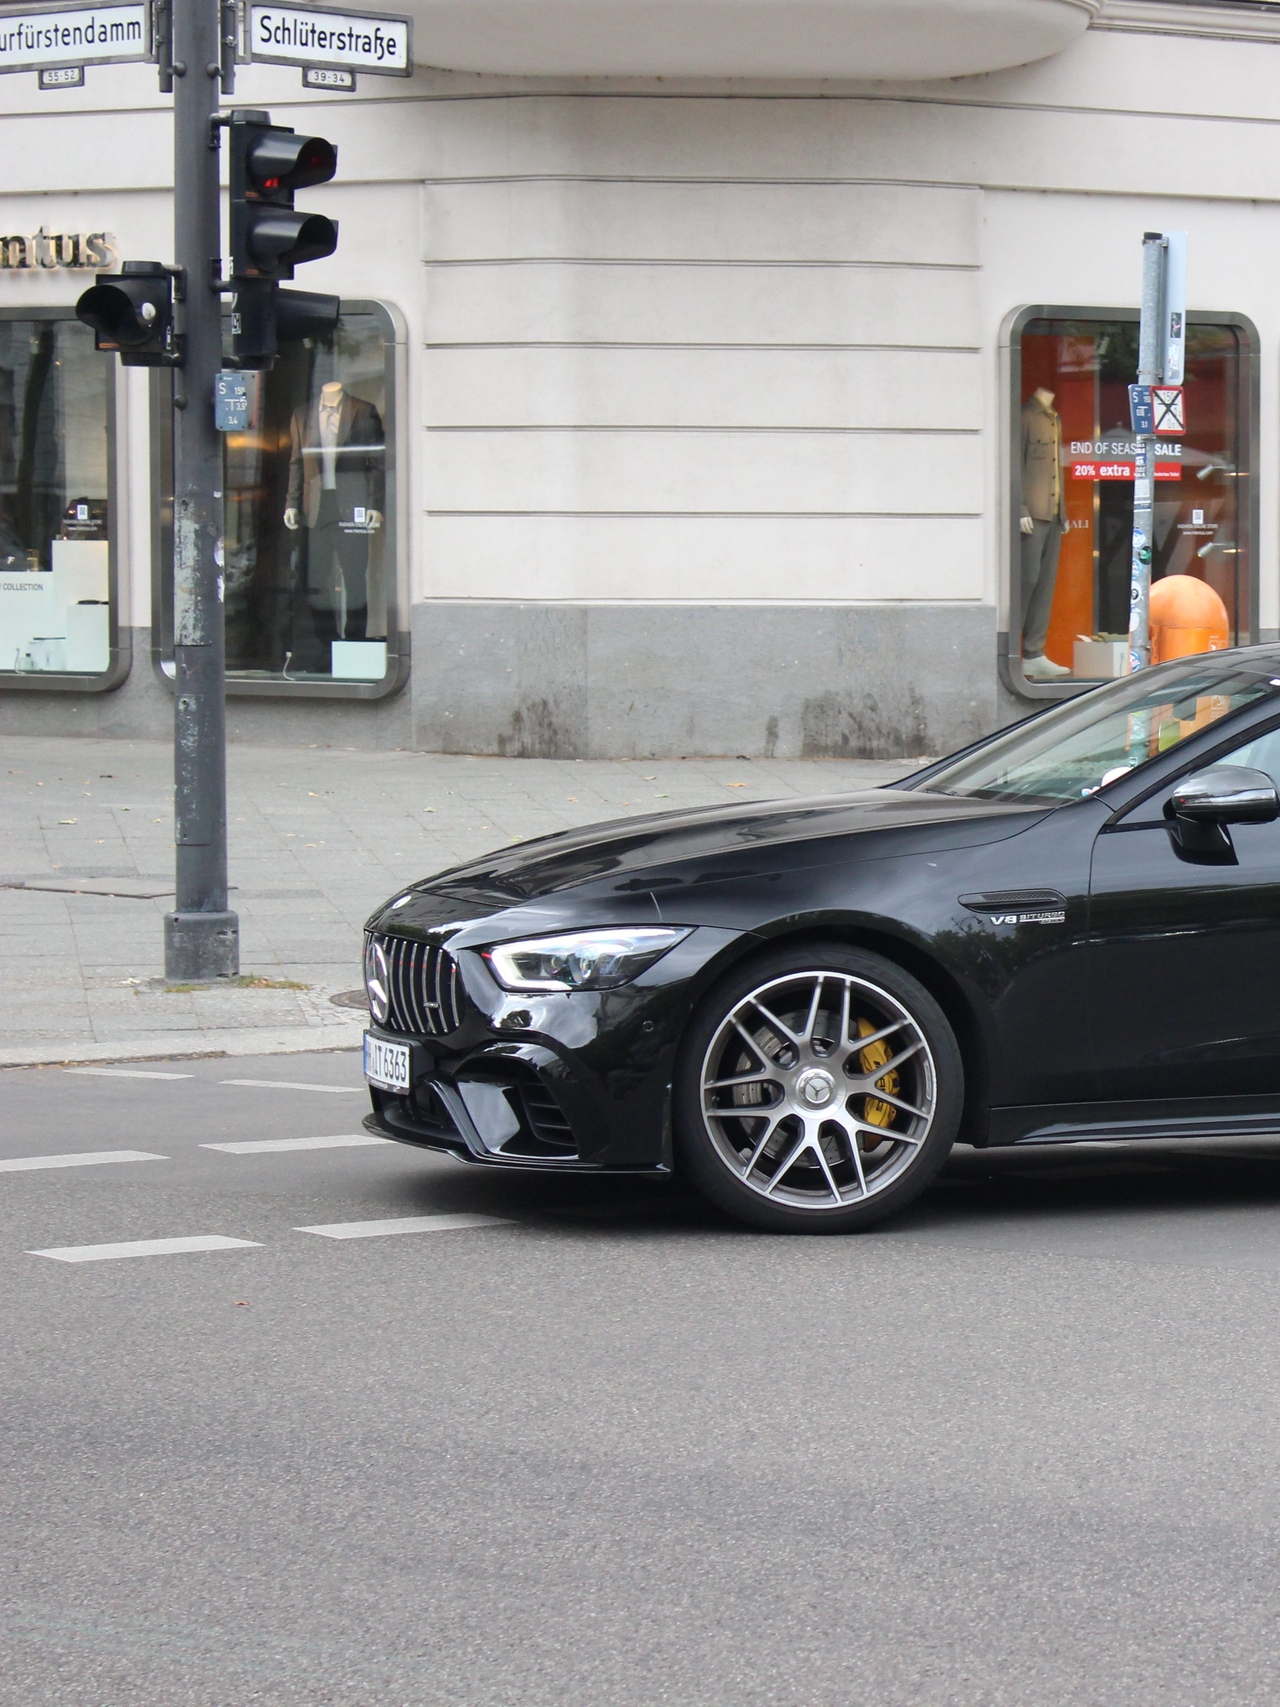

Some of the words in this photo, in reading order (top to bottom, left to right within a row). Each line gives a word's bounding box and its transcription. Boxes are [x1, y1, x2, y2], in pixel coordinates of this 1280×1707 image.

[260, 15, 397, 60] Schlüterstraße
[48, 70, 75, 82] 55-52
[314, 71, 345, 83] 39-34
[1070, 441, 1092, 454] END
[1094, 442, 1109, 454] OF
[1111, 442, 1138, 455] SEAS
[1154, 443, 1182, 456] SALE
[1075, 465, 1095, 476] 20%
[1099, 464, 1130, 476] extra
[2, 582, 44, 591] COLLECTION
[990, 915, 1018, 925] V8
[384, 1047, 407, 1082] 6363
